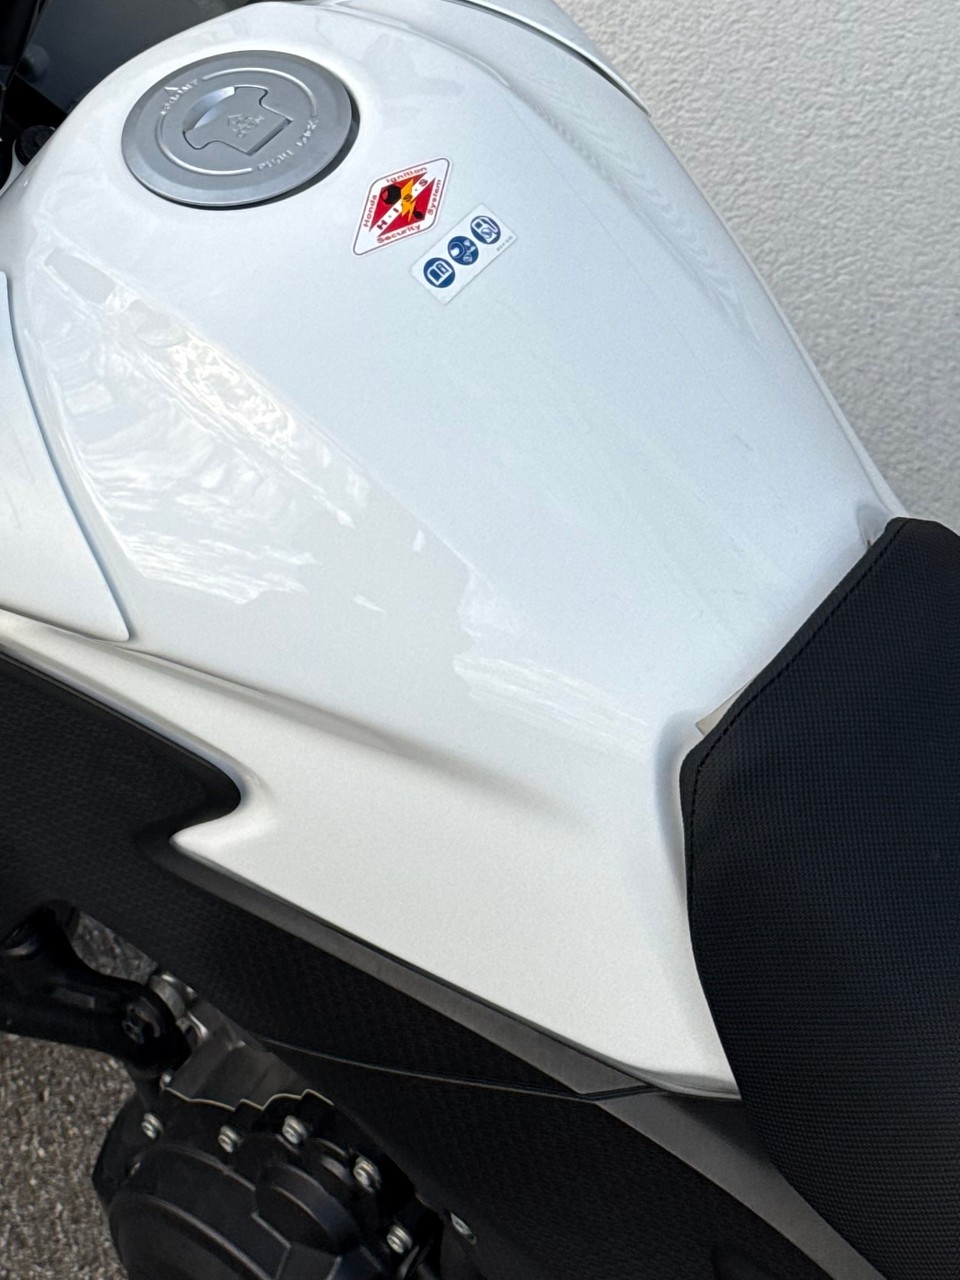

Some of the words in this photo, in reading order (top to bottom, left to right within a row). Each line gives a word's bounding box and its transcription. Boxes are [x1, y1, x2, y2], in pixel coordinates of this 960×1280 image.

[385, 166, 428, 184] Ignition
[362, 194, 378, 228] Honda
[427, 179, 442, 216] System
[376, 223, 422, 244] Security
